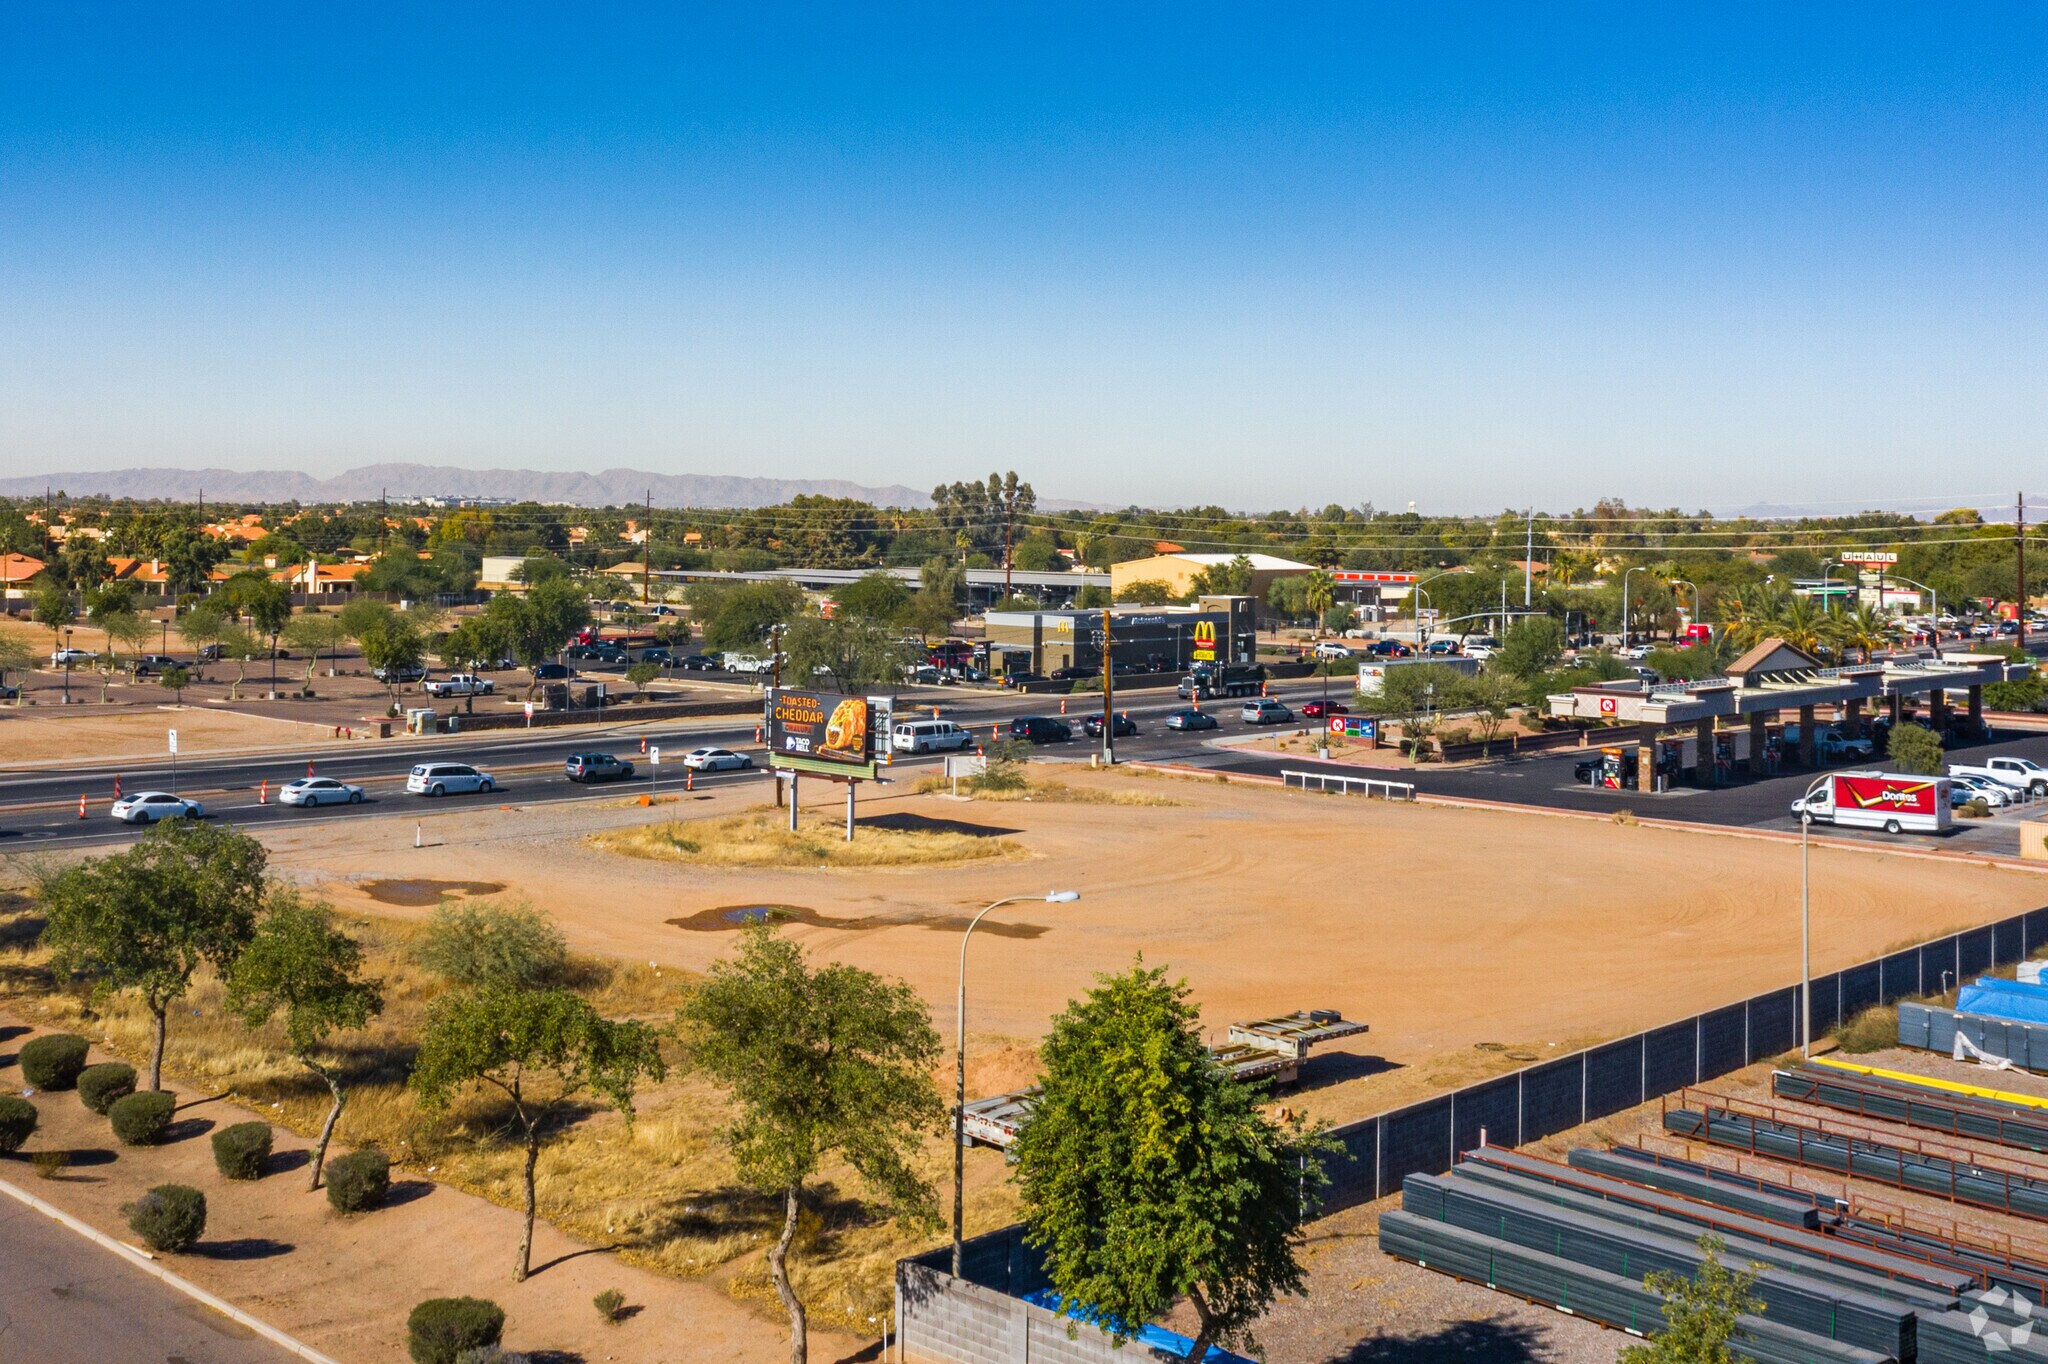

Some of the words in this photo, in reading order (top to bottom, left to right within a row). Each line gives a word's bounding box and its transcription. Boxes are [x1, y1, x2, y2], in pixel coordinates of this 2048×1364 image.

[775, 706, 824, 723] CHEDDAR
[795, 737, 810, 745] TACO
[796, 744, 810, 752] BELL
[1882, 790, 1917, 802] Doritos
